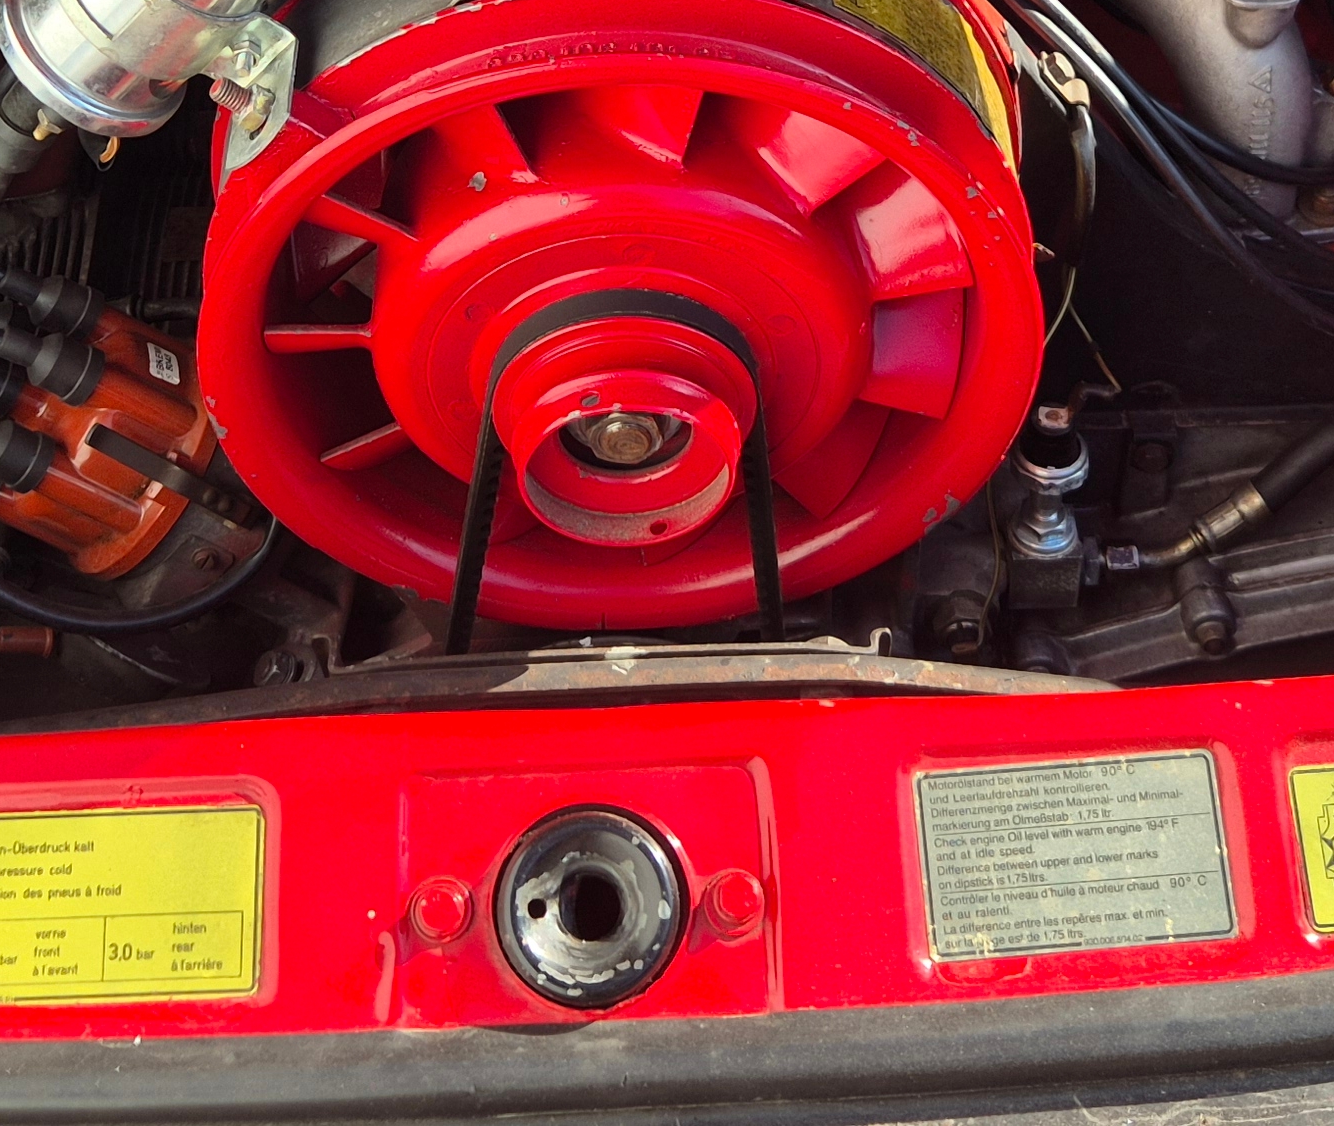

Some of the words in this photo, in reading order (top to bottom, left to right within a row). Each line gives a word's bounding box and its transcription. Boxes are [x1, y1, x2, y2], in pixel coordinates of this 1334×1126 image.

[927, 776, 995, 791] Motorölstand
[997, 774, 1013, 785] bei
[1016, 771, 1061, 783] warmem
[1063, 769, 1093, 780] Motor
[1125, 764, 1136, 775] C
[929, 793, 949, 805] und
[953, 787, 1040, 803] Leerlaufdrehzahl
[1043, 782, 1110, 795] kontrollieren.
[930, 803, 1013, 819] Differenzmenge
[1015, 798, 1064, 811] zwischen
[1066, 794, 1114, 807] Maximal-
[1116, 792, 1137, 803] und
[1138, 789, 1184, 802] Minimal-
[932, 817, 991, 833] markierung
[993, 817, 1010, 827] am
[1078, 809, 1099, 821] 1,75
[934, 836, 967, 848] Check
[970, 834, 1005, 847] engine
[1007, 831, 1023, 842] Oil
[1025, 829, 1049, 841] level
[1051, 828, 1073, 839] with
[1075, 826, 1104, 837] warm
[1107, 822, 1142, 836] engine
[1171, 817, 1180, 828] F
[73, 840, 95, 853] kalt
[936, 849, 956, 861] and
[960, 849, 972, 860] at
[975, 846, 995, 859] idle
[999, 844, 1035, 860] speed.
[49, 863, 73, 875] cold
[937, 863, 990, 876] Difference
[993, 859, 1038, 872] between
[1040, 857, 1070, 870] upper
[1072, 854, 1093, 865] and
[1095, 852, 1123, 863] lower
[1126, 849, 1159, 860] marks
[938, 880, 952, 890] on
[954, 875, 994, 890] dipstick
[996, 875, 1005, 885] is
[940, 894, 989, 907] Contrôler
[991, 892, 1001, 903] le
[1003, 889, 1038, 902] niveau
[1041, 886, 1076, 898] d'huile
[1078, 884, 1086, 896] à
[1087, 882, 1125, 894] moteur
[1127, 879, 1159, 892] chaud
[1197, 874, 1207, 886] C
[23, 886, 43, 899] des
[47, 886, 82, 901] pneus
[96, 884, 122, 897] froid
[942, 910, 953, 921] et
[957, 910, 971, 920] au
[975, 906, 1013, 918] ralenti.
[943, 925, 957, 935] La
[1014, 918, 1042, 929] entre
[1043, 916, 1060, 927] les
[1061, 913, 1102, 927] repères
[1104, 911, 1130, 922] max.
[1132, 909, 1144, 920] et
[1146, 907, 1168, 919] min.
[172, 921, 207, 935] hinten
[171, 941, 195, 953] rear
[944, 939, 962, 950] sur
[964, 937, 974, 948] la
[1027, 931, 1041, 943] de
[0, 954, 18, 966] bar
[33, 945, 61, 958] front
[108, 942, 133, 962] 3,0
[136, 948, 155, 961] bar
